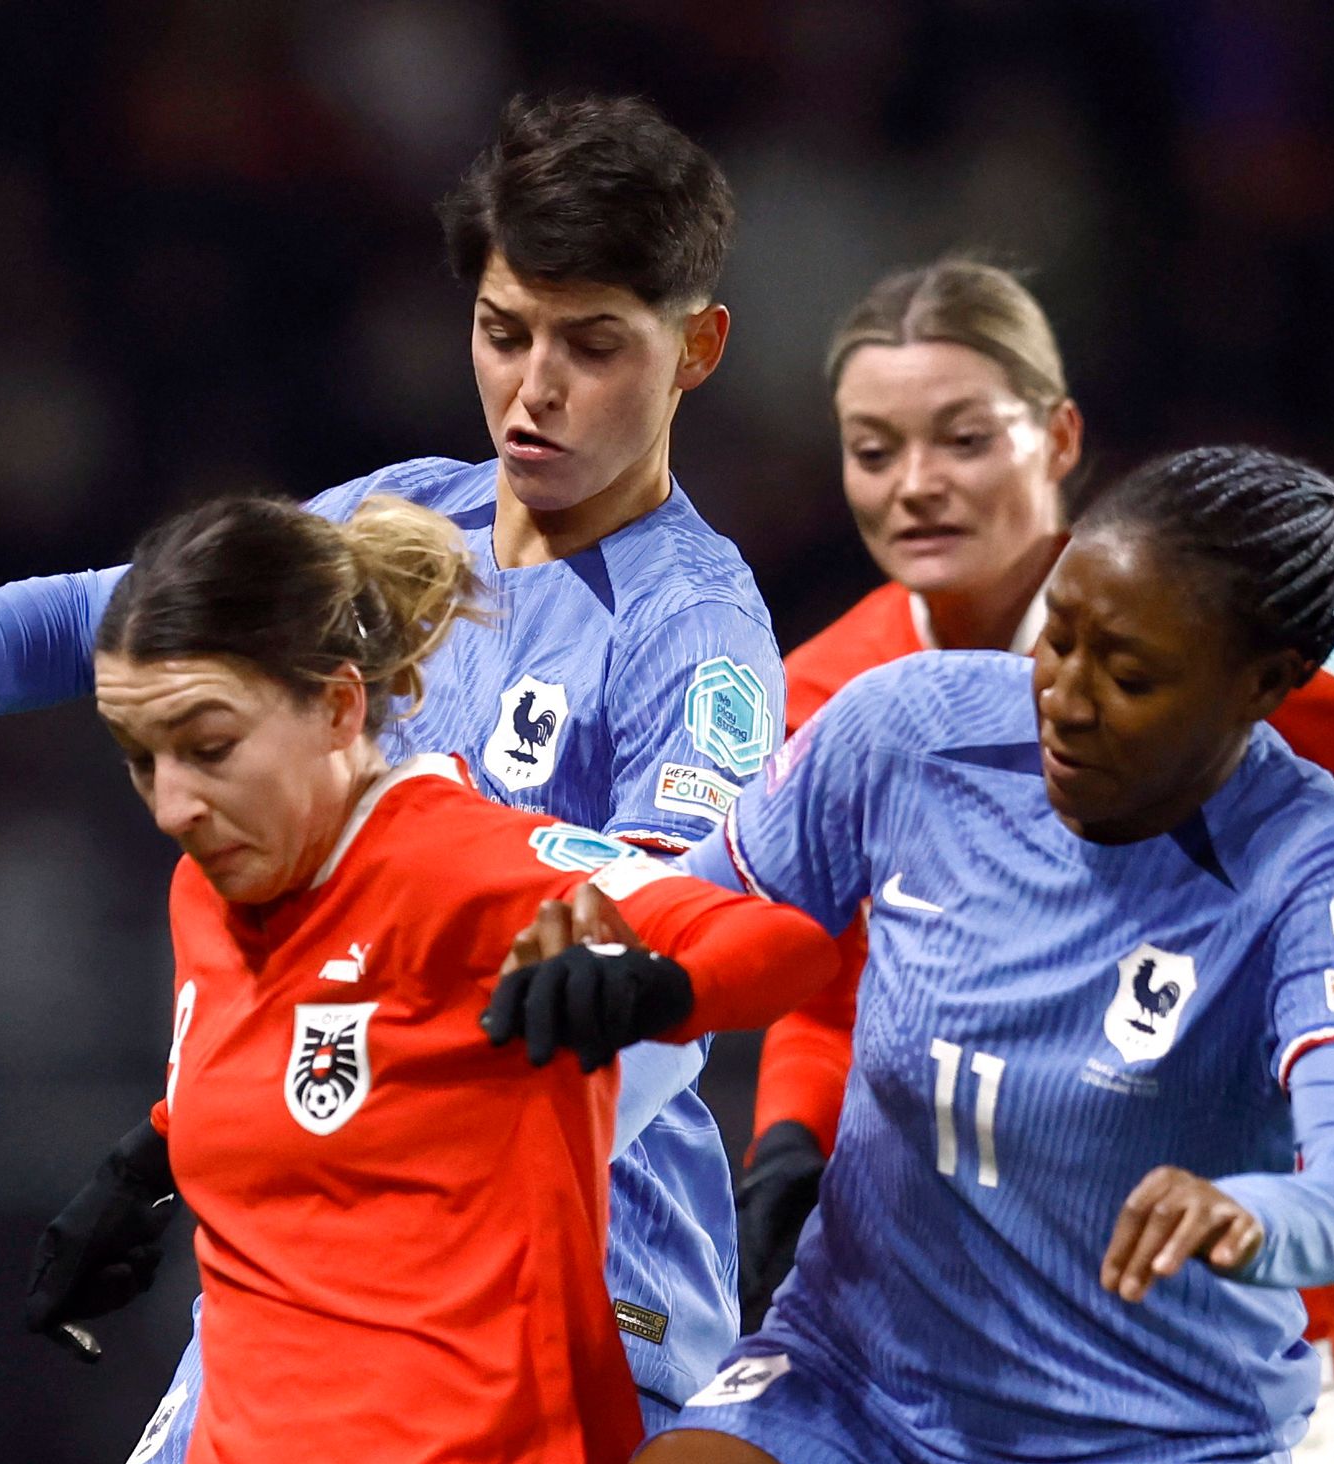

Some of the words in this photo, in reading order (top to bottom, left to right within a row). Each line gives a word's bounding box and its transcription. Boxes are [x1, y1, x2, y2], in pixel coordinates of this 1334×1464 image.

[716, 716, 748, 743] strong
[665, 767, 697, 779] UEFA
[929, 1038, 1006, 1189] 11
